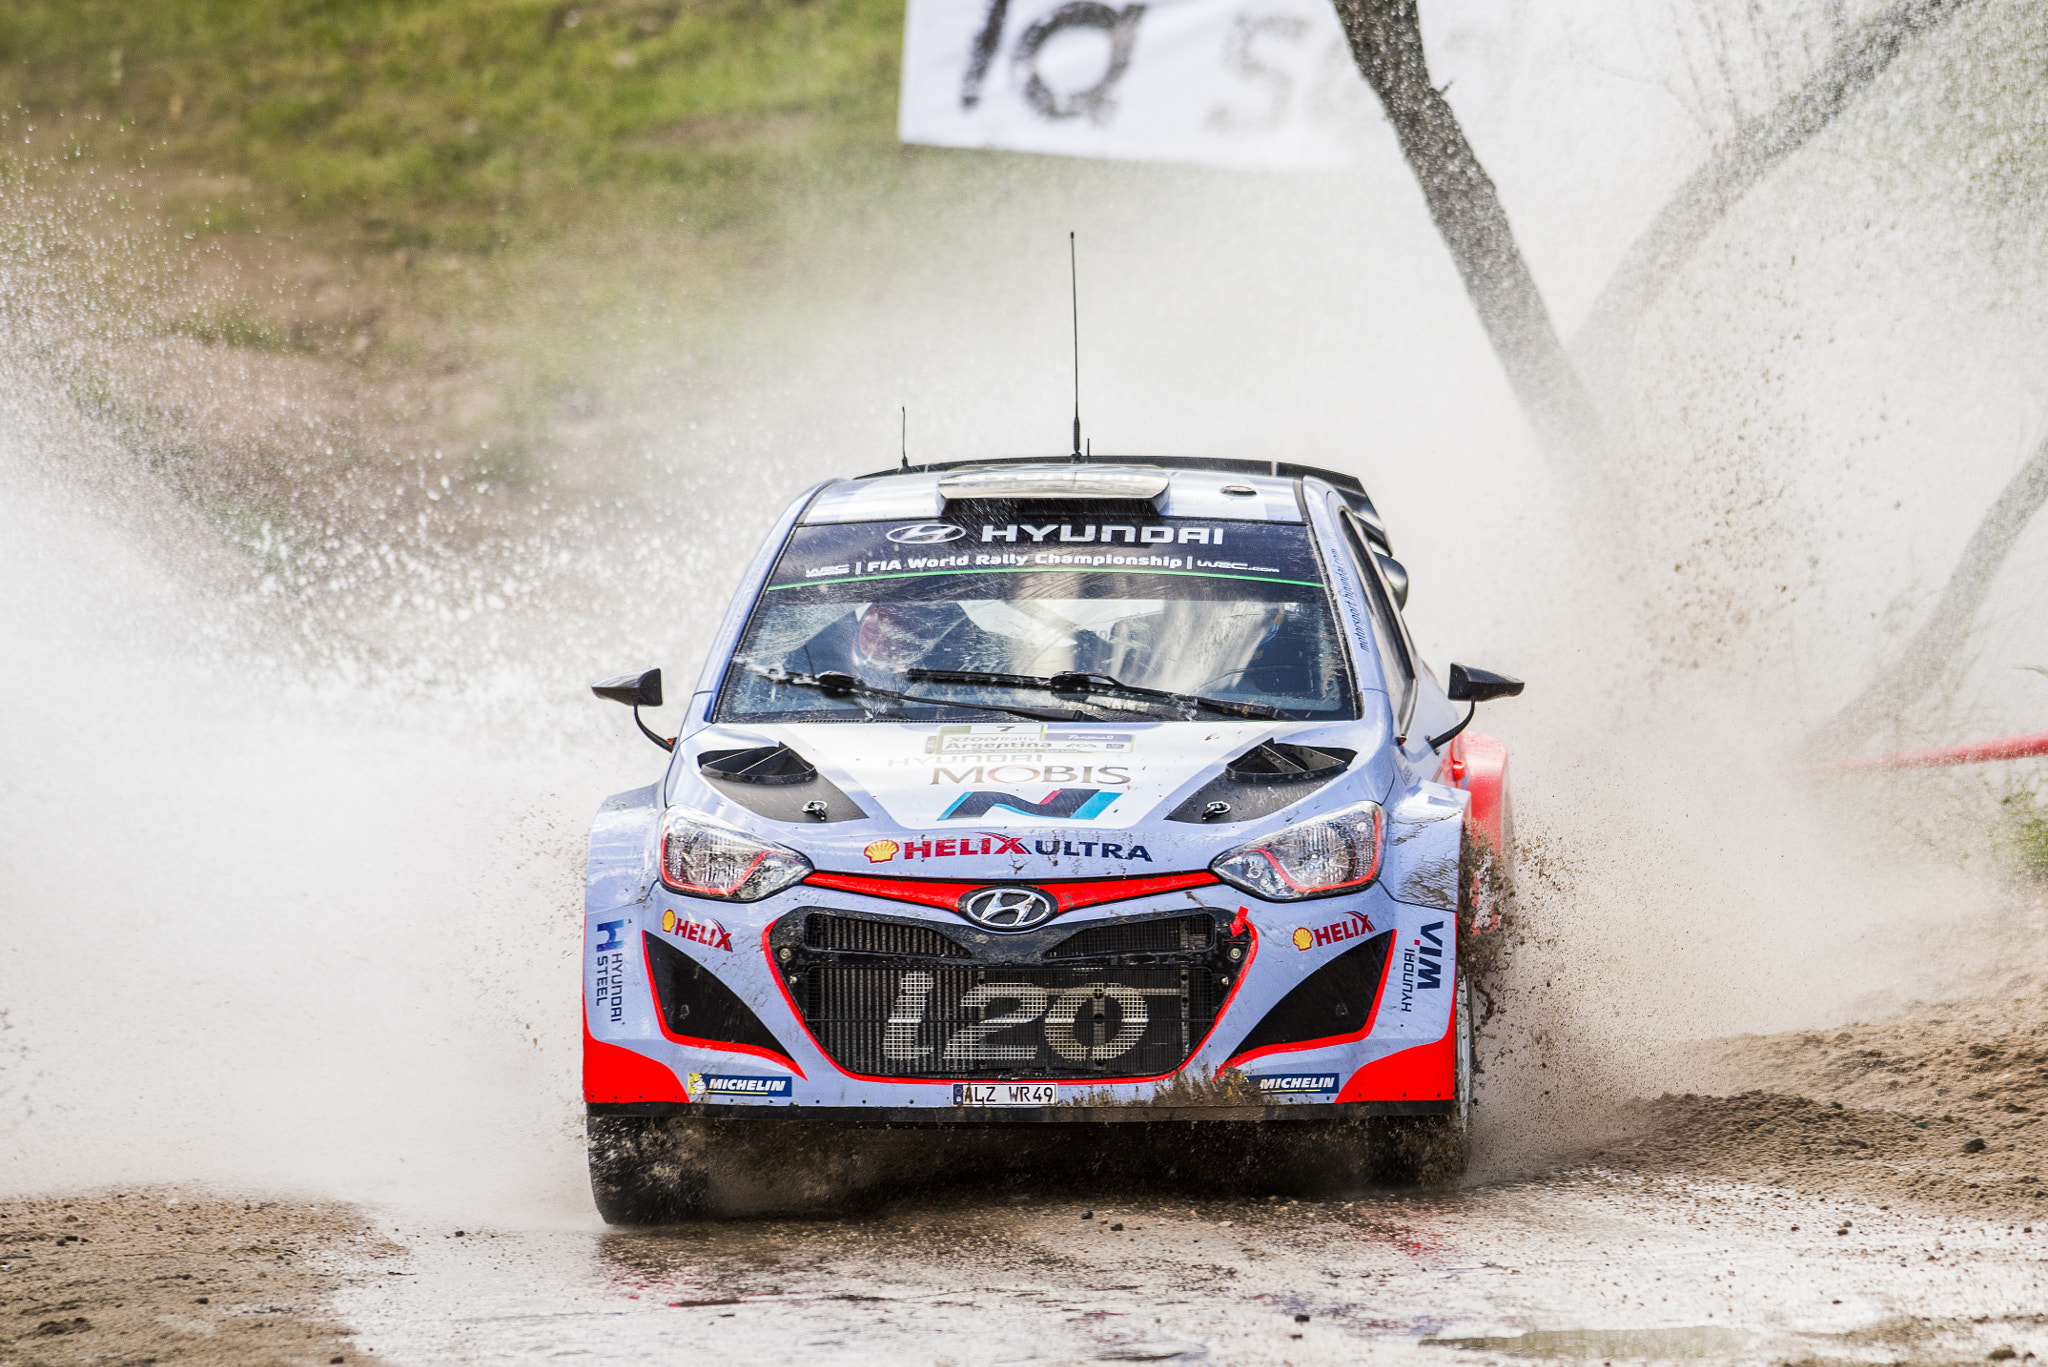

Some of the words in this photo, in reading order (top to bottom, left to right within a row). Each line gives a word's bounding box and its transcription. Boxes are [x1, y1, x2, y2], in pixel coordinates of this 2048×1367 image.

[981, 524, 1224, 545] HYUNDAI
[867, 560, 902, 572] FIA
[907, 555, 969, 569] World
[975, 553, 1029, 567] Rally
[1034, 553, 1182, 569] Championship
[945, 742, 1053, 752] Argentina
[888, 754, 1043, 767] HYUNDAI
[929, 765, 1132, 786] MOBIS
[903, 832, 1031, 860] HELIX
[1035, 839, 1154, 863] ULTRA
[674, 918, 734, 953] HELIX
[1312, 911, 1377, 948] HELIX
[596, 955, 609, 1007] STEEL
[610, 952, 624, 1023] HYUNDAI
[1401, 948, 1416, 1013] HYUNDAI
[882, 970, 1150, 1060] i20
[709, 1078, 787, 1092] MICHELIN
[965, 1085, 996, 1103] ALZ
[1259, 1077, 1336, 1090] MICHELIN
